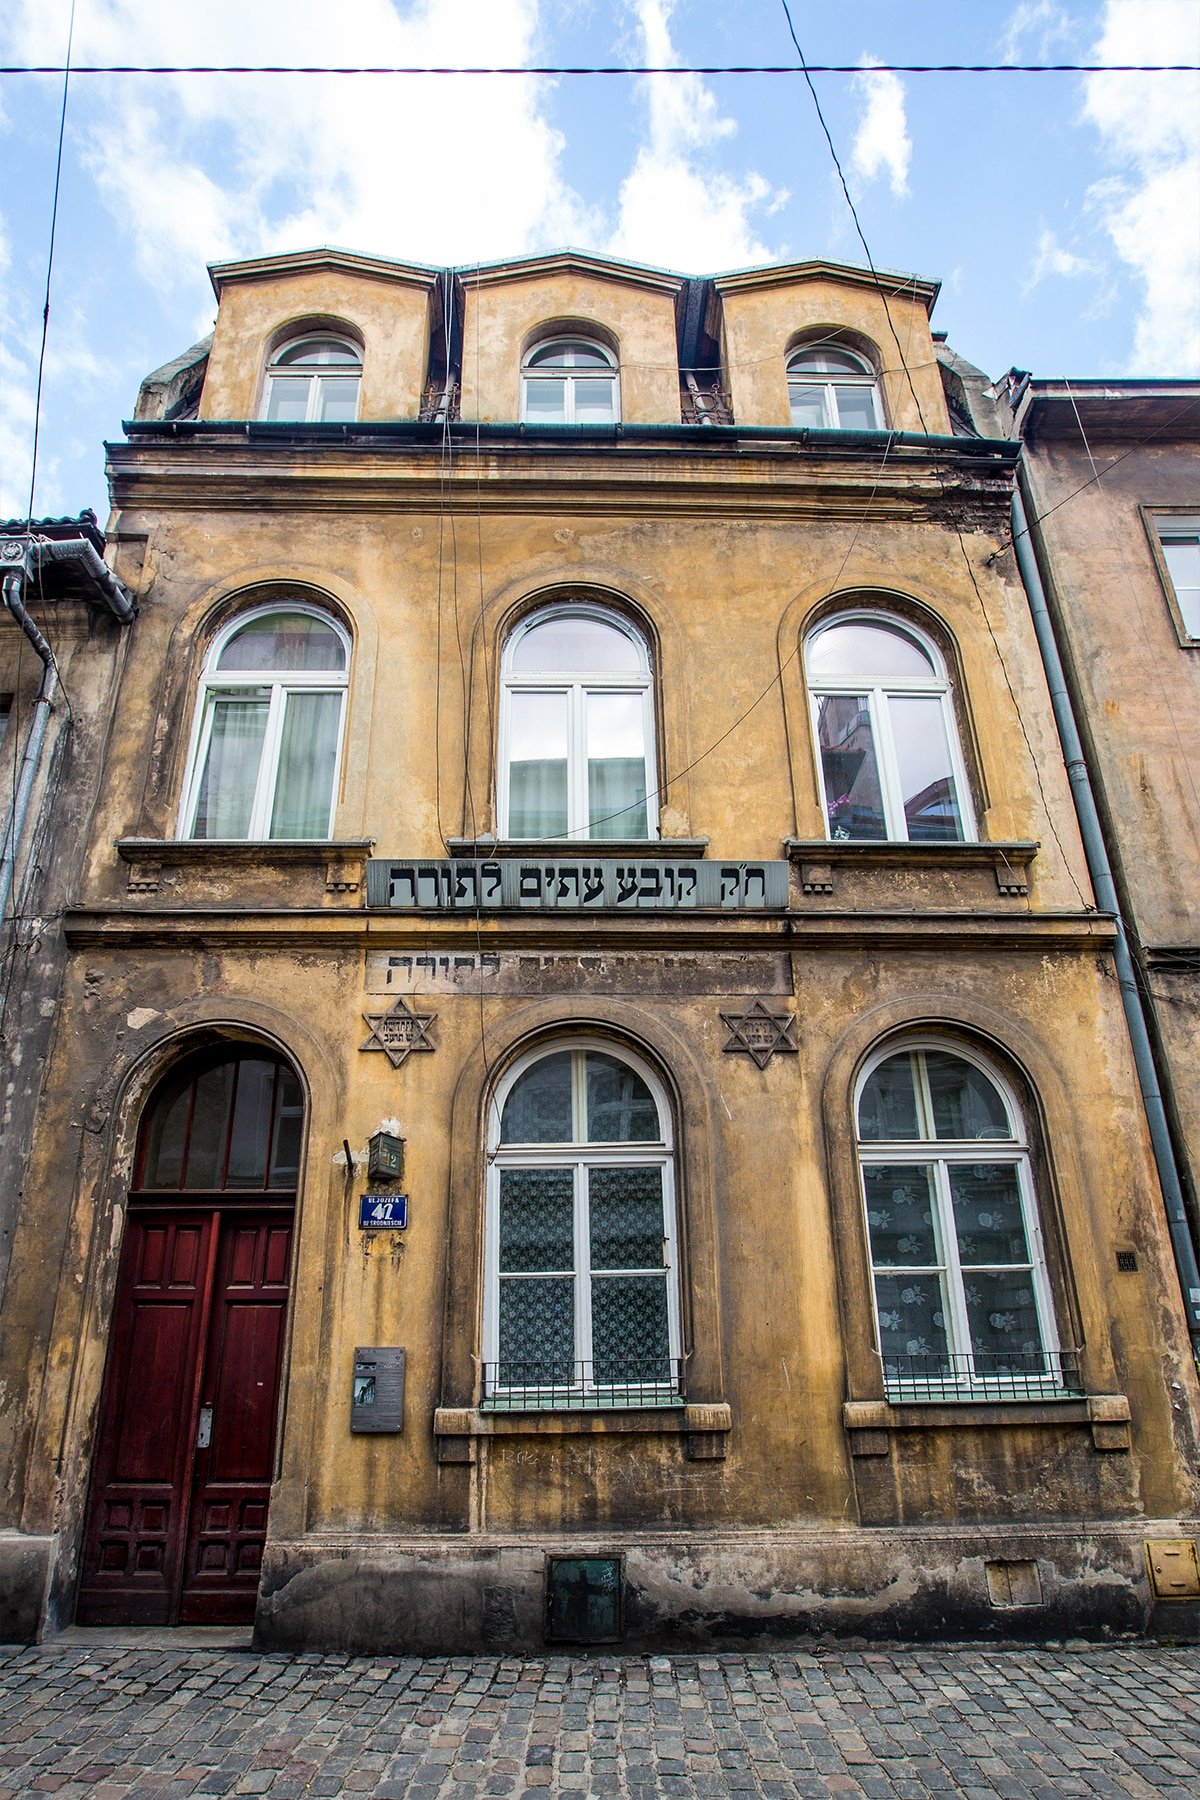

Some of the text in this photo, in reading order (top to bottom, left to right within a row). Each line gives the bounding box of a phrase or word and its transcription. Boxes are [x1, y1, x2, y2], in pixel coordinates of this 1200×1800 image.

[389, 862, 502, 898] לתורה
[519, 868, 605, 904] עתים
[616, 868, 698, 904] קובע
[371, 1203, 394, 1220] 42
